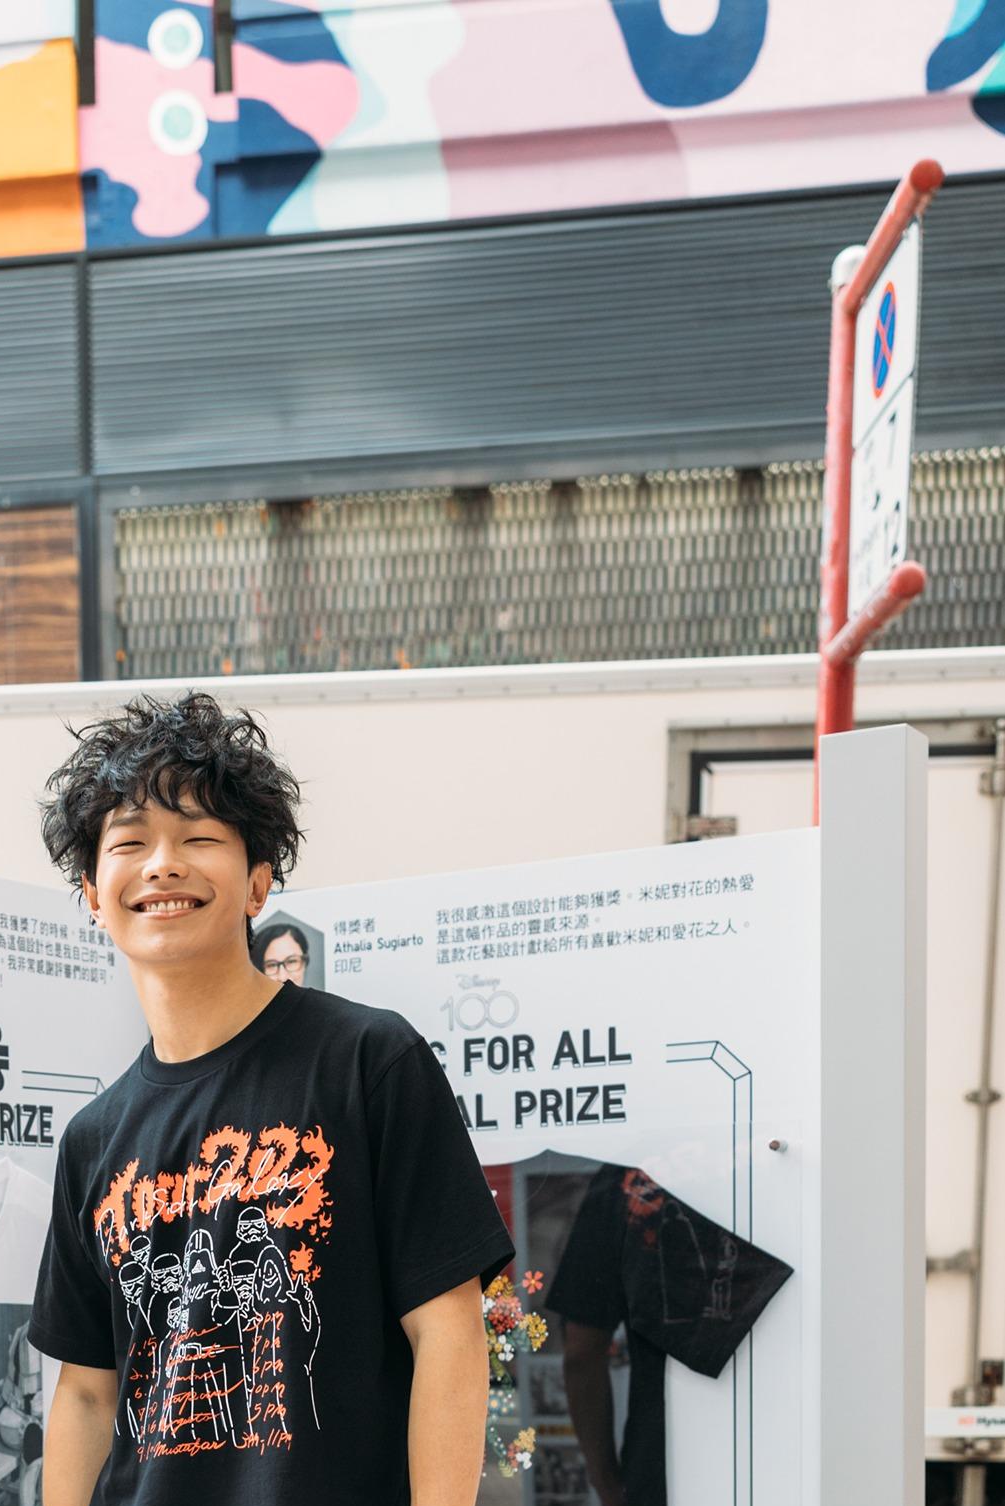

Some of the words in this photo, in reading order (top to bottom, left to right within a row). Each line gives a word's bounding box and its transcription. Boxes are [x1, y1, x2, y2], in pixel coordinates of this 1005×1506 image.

[333, 918, 376, 936] 得獎者
[333, 941, 374, 955] Athalia
[376, 934, 425, 952] Sugiarto
[333, 956, 363, 974] 印尼
[439, 989, 520, 1032] 100
[464, 1034, 536, 1077] FOR
[551, 1026, 633, 1070] ALL
[515, 1083, 627, 1129] PRIZE
